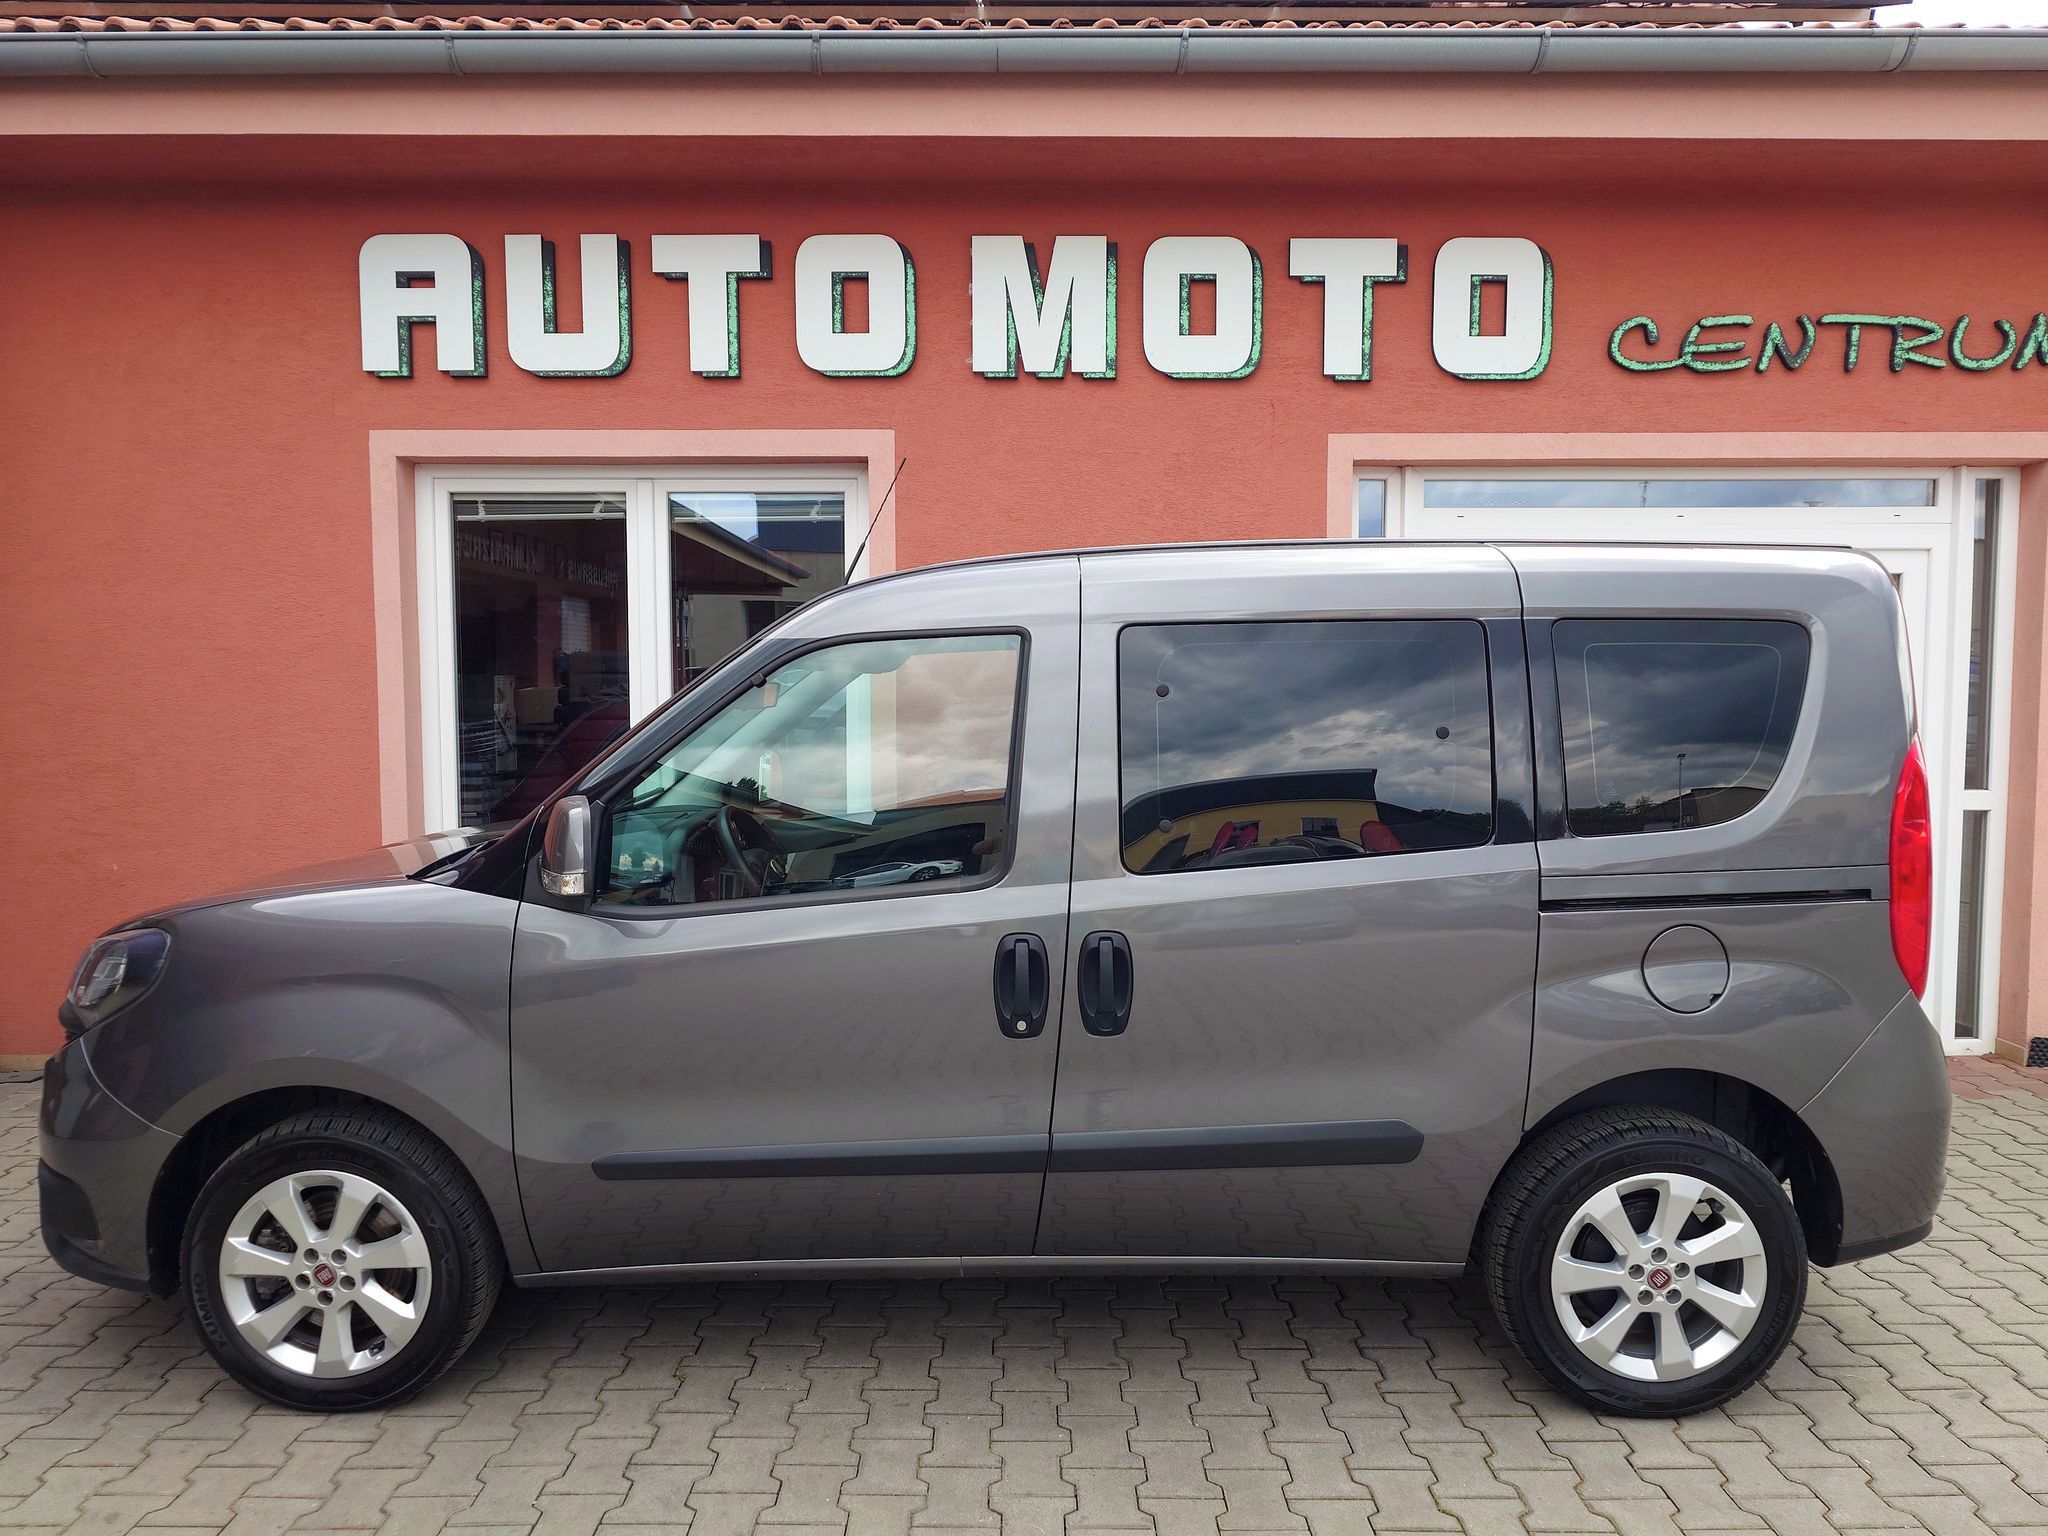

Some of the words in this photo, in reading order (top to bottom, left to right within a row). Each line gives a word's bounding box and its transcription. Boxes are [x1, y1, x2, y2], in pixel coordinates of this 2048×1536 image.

[359, 233, 916, 378] AUTO
[971, 235, 1554, 381] MOTO
[1652, 1270, 1669, 1287] FIAT
